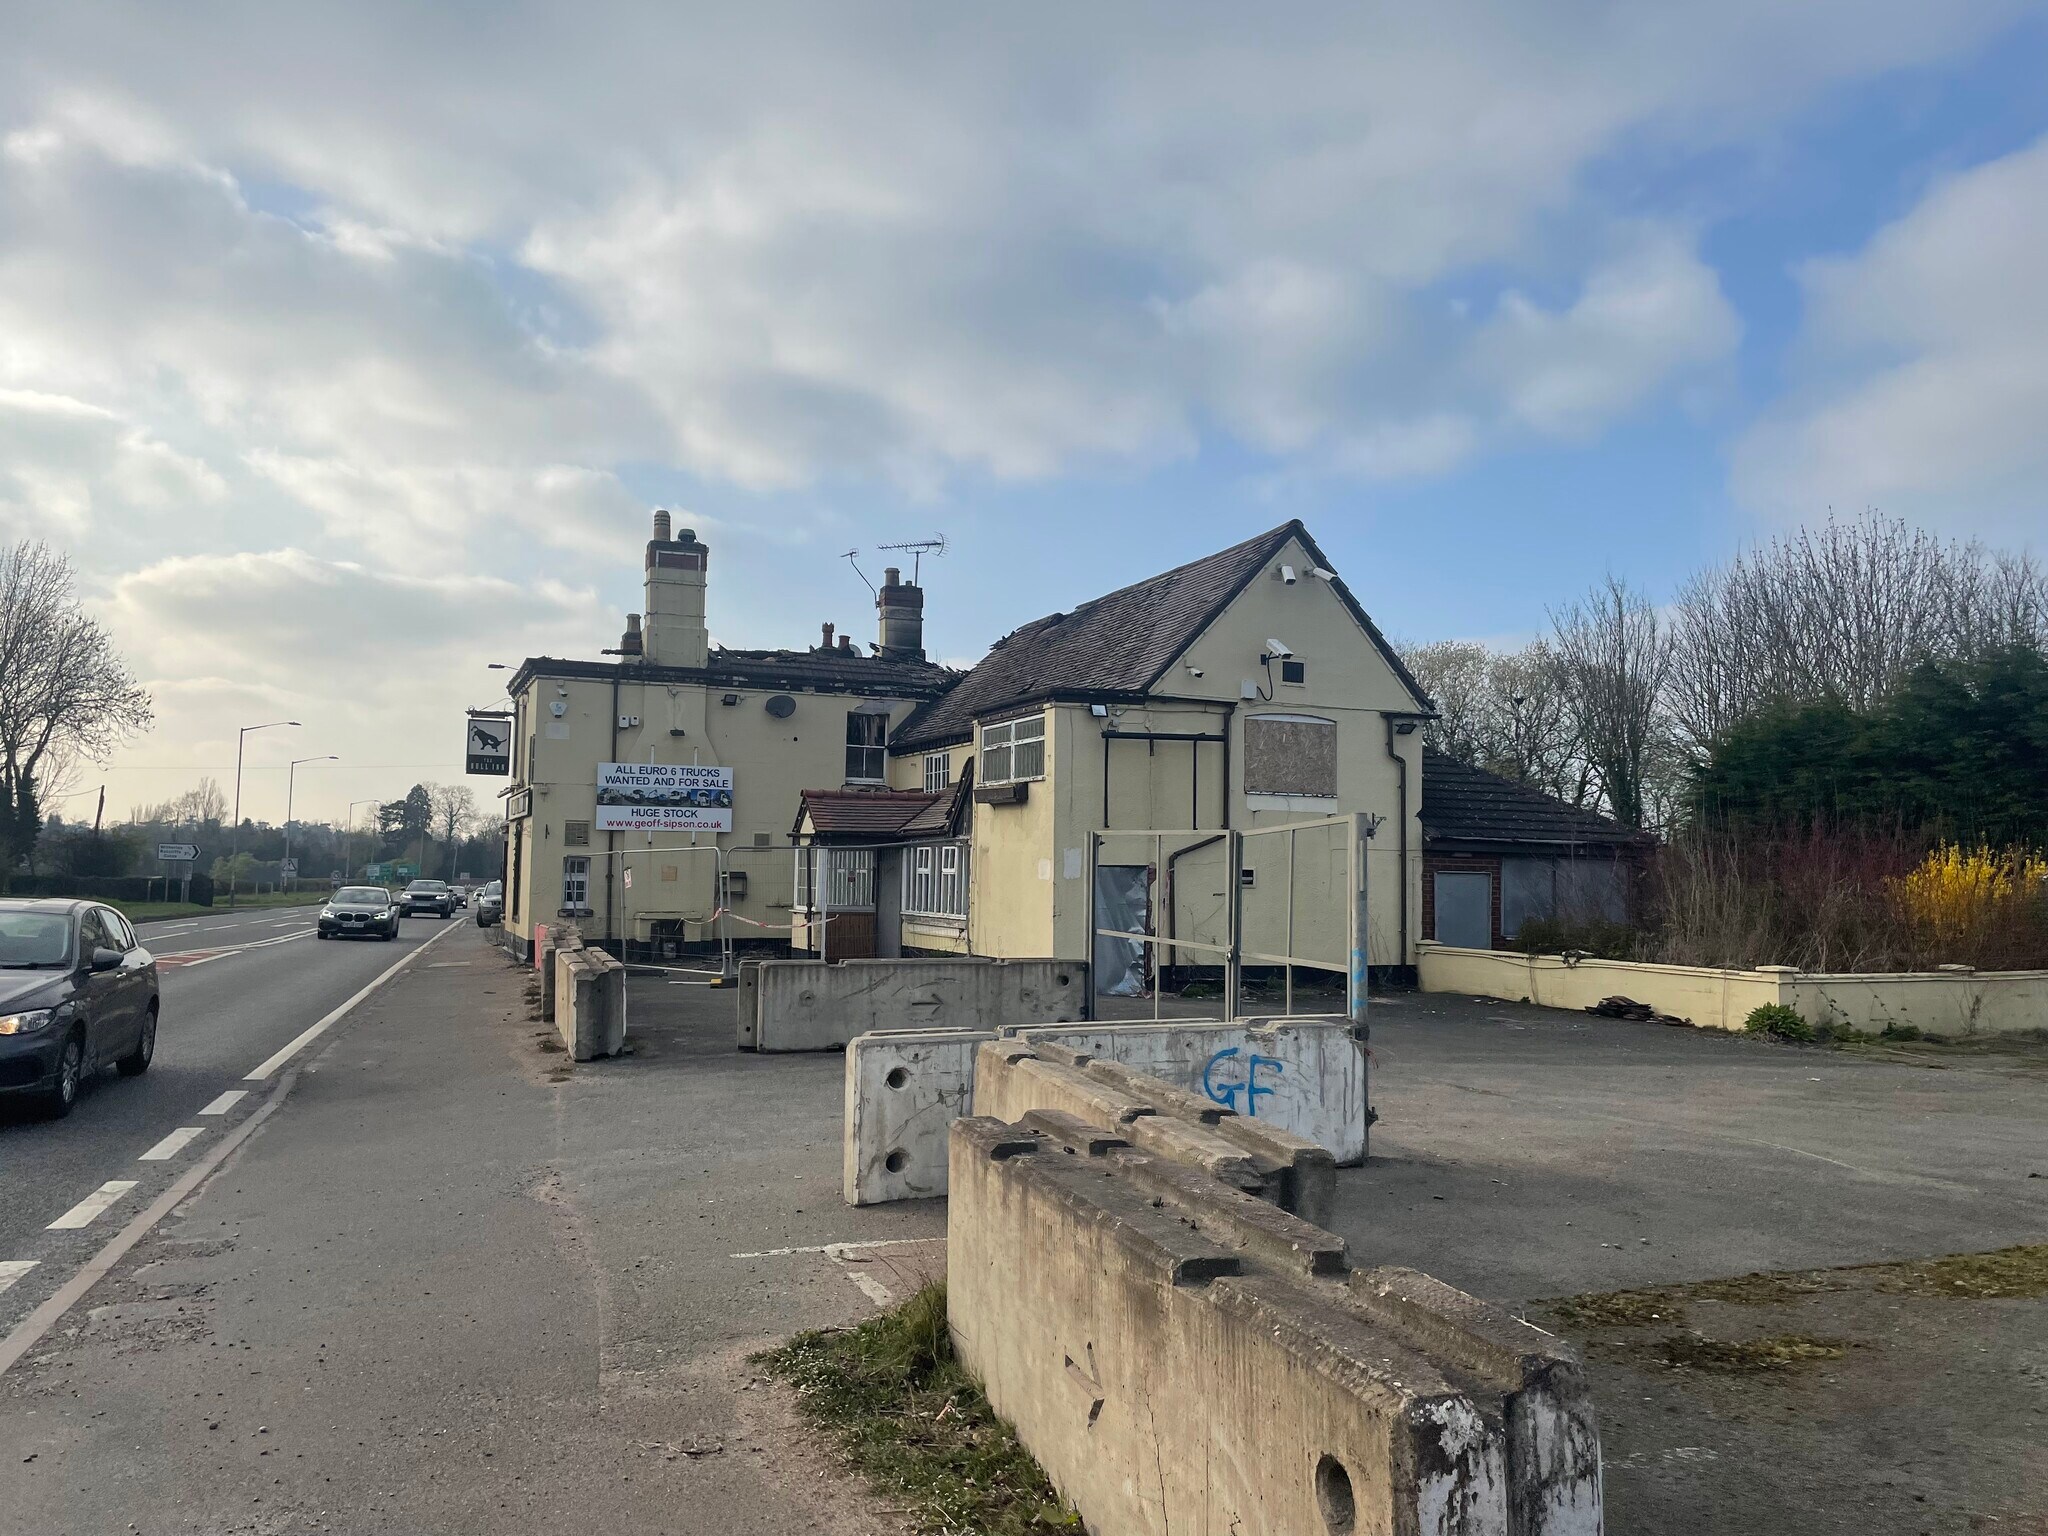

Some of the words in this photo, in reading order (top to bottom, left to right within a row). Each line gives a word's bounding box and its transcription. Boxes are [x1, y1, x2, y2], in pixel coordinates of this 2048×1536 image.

[615, 766, 635, 774] ALL
[639, 767, 667, 775] EURO
[680, 768, 720, 777] TRUCKS
[605, 776, 650, 785] WANTED
[654, 778, 675, 786] AND
[679, 779, 699, 787] FOR
[702, 779, 728, 787] SALE
[631, 809, 660, 817] HUGE
[664, 810, 698, 818] STOCK
[607, 819, 722, 829] www.geoff-sipson.co.uk
[1203, 1047, 1283, 1116] GF
